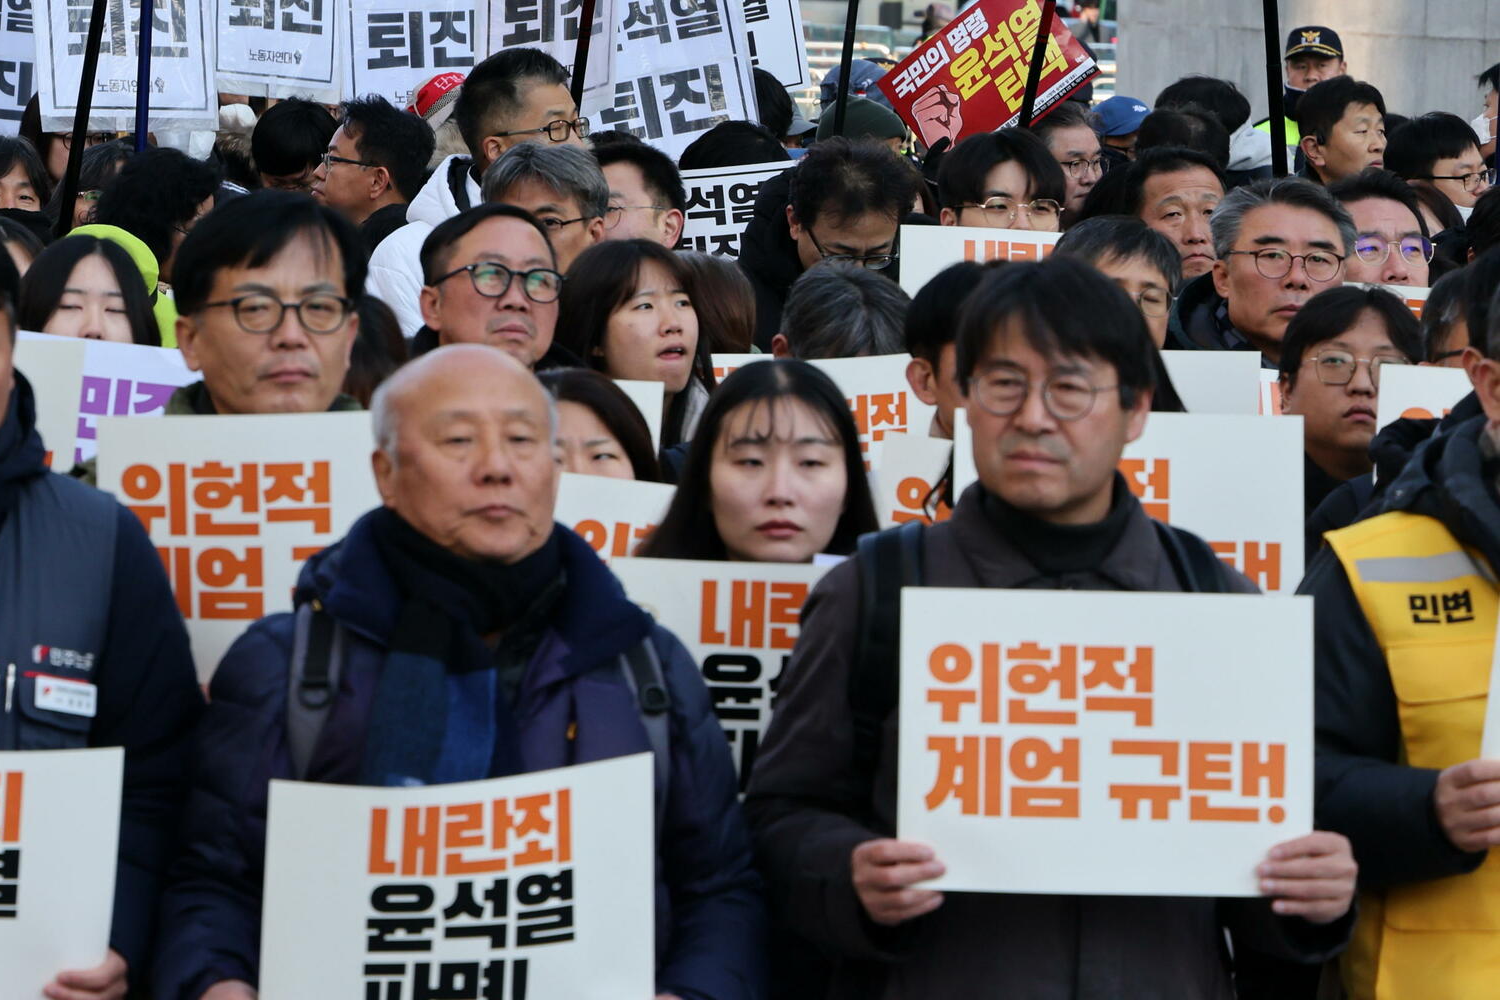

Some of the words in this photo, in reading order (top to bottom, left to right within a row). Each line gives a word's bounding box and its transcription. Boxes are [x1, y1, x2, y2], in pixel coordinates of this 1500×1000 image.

[248, 49, 293, 65] 노동자연대
[367, 9, 475, 70] 퇴진
[892, 38, 951, 99] 국민의
[946, 7, 990, 54] 명령
[121, 460, 332, 537] 위헌적
[1408, 588, 1475, 625] 민변
[926, 641, 1155, 727] 위헌적
[925, 735, 1081, 819] 계엄
[1109, 739, 1287, 825] 규탄!
[368, 787, 573, 877] 내란죄
[365, 867, 576, 952] 윤석열
